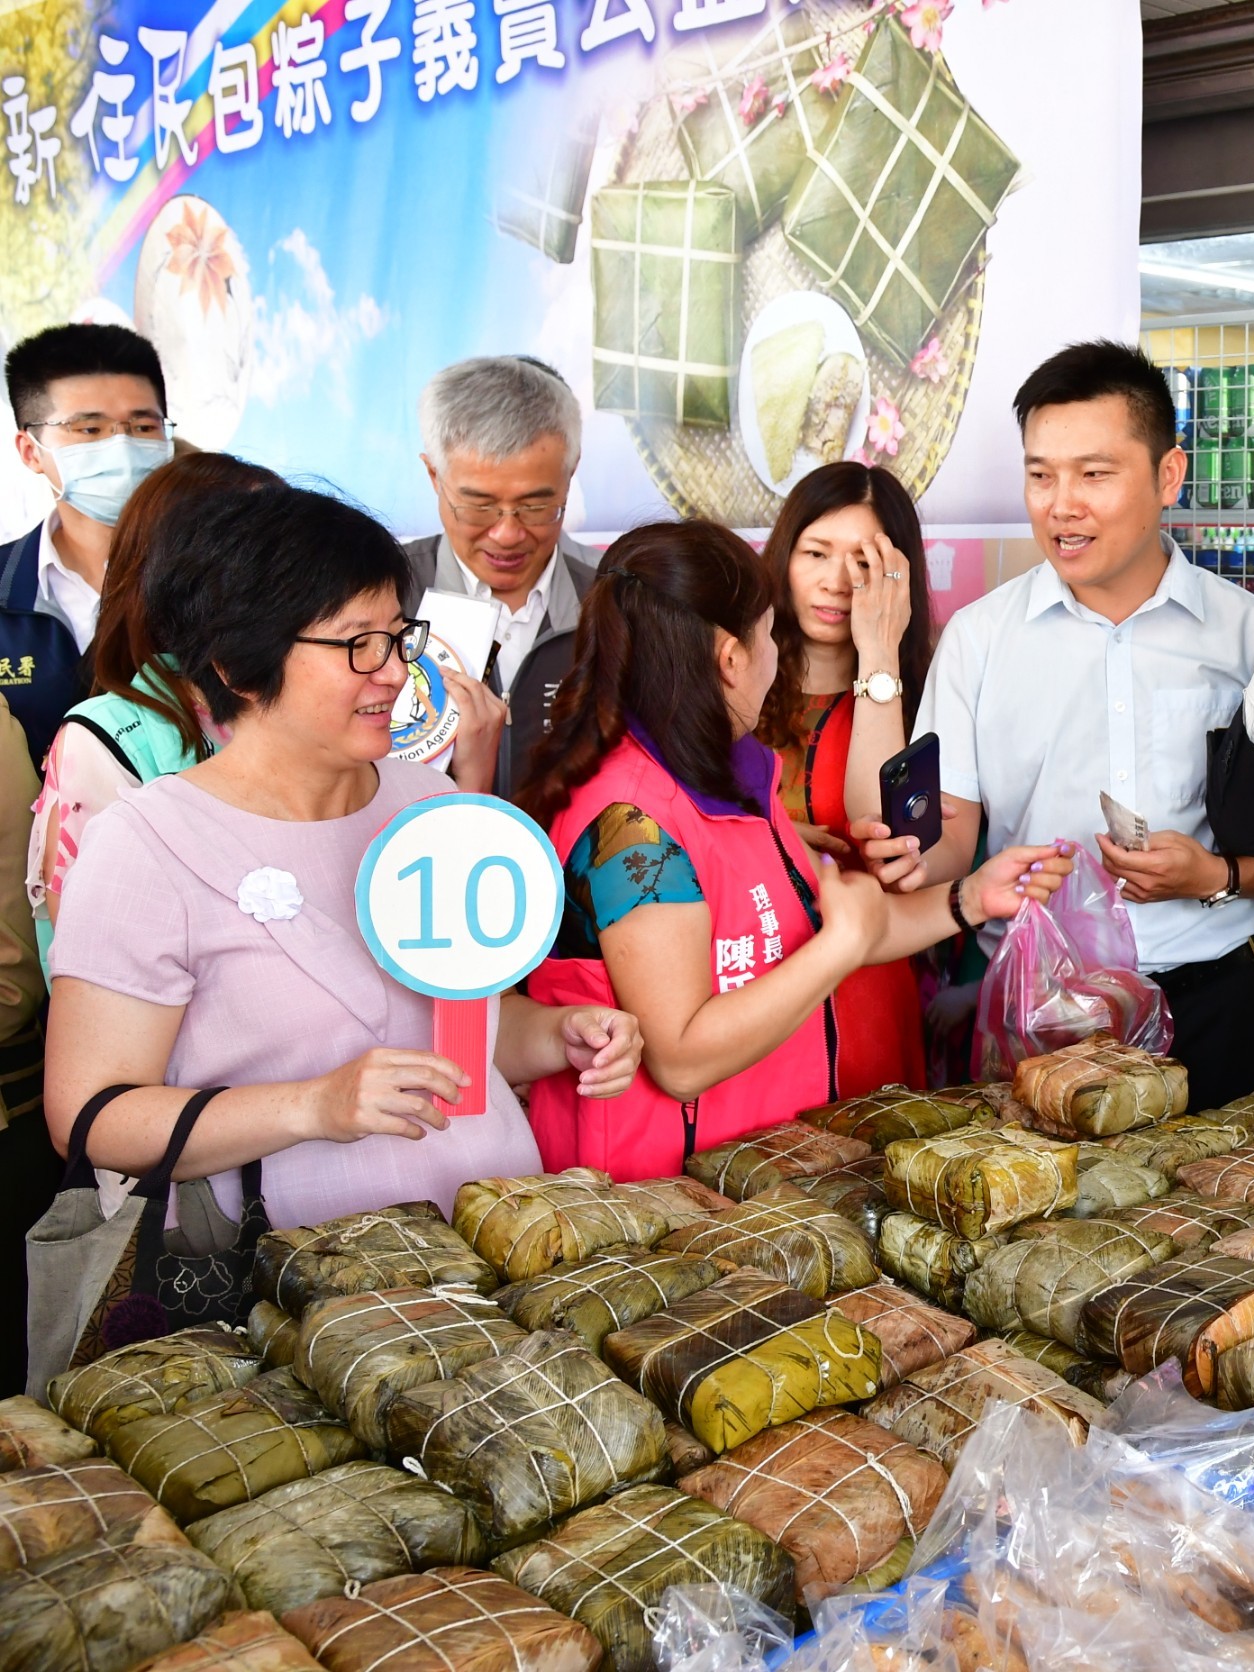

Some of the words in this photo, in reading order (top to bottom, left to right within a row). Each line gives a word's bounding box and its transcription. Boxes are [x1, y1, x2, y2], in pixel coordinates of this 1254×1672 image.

[425, 708, 460, 750] Agency
[397, 855, 527, 949] 10
[749, 883, 784, 964] 理事長
